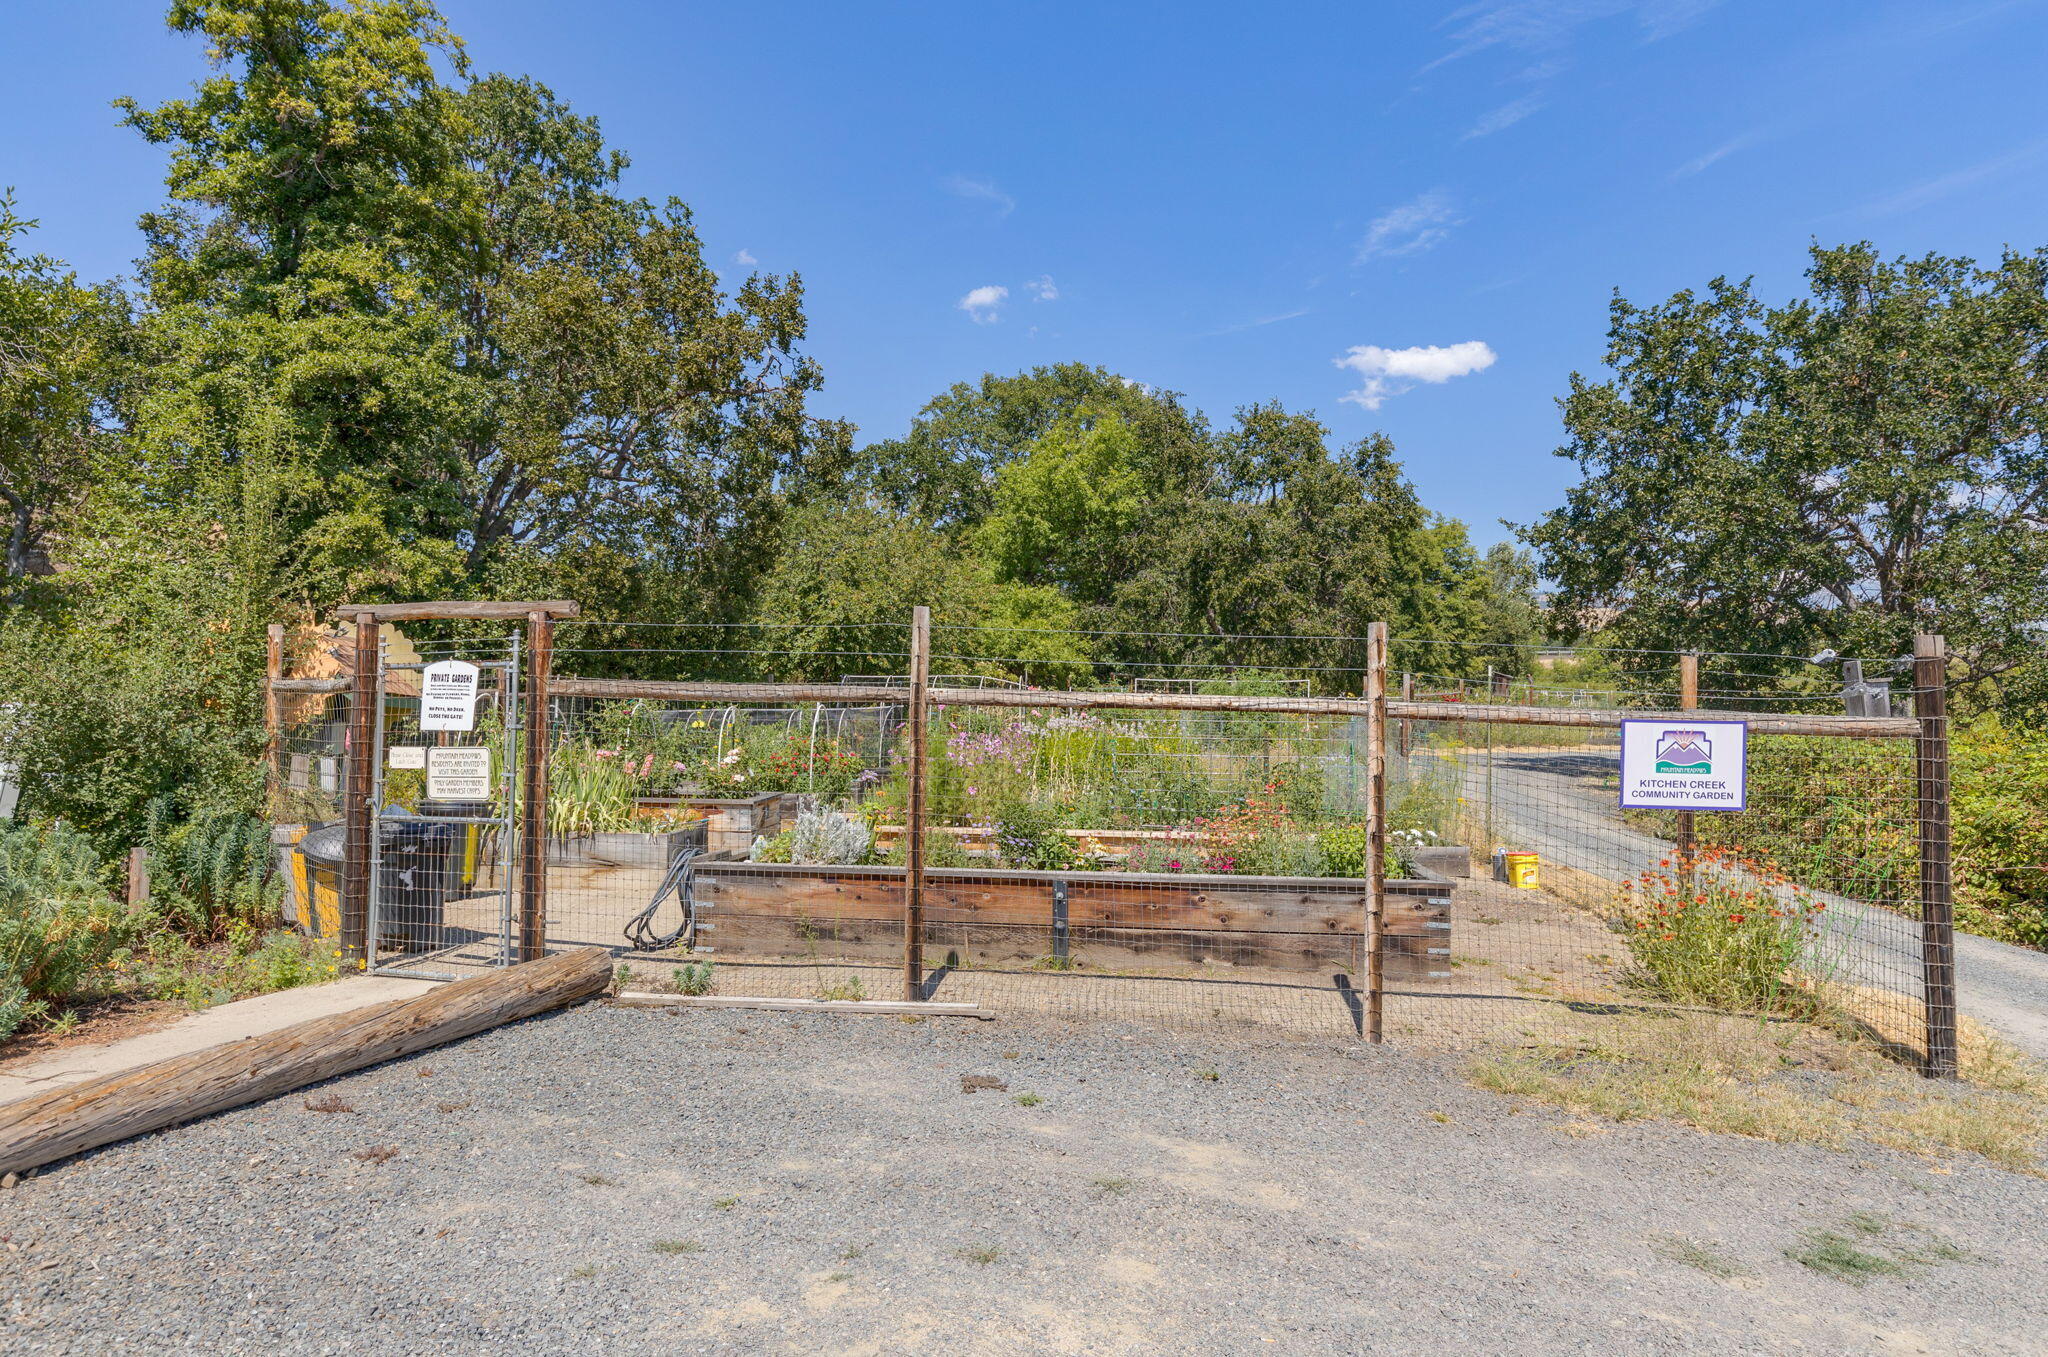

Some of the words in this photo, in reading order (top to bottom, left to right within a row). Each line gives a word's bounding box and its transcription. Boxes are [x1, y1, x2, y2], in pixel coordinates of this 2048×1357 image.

[430, 674, 450, 682] PRIVATE
[452, 674, 472, 683] GARDENS
[1640, 780, 1687, 788] KITCHEN
[1690, 780, 1726, 789] CREEK
[1632, 790, 1690, 799] COMMUNITY
